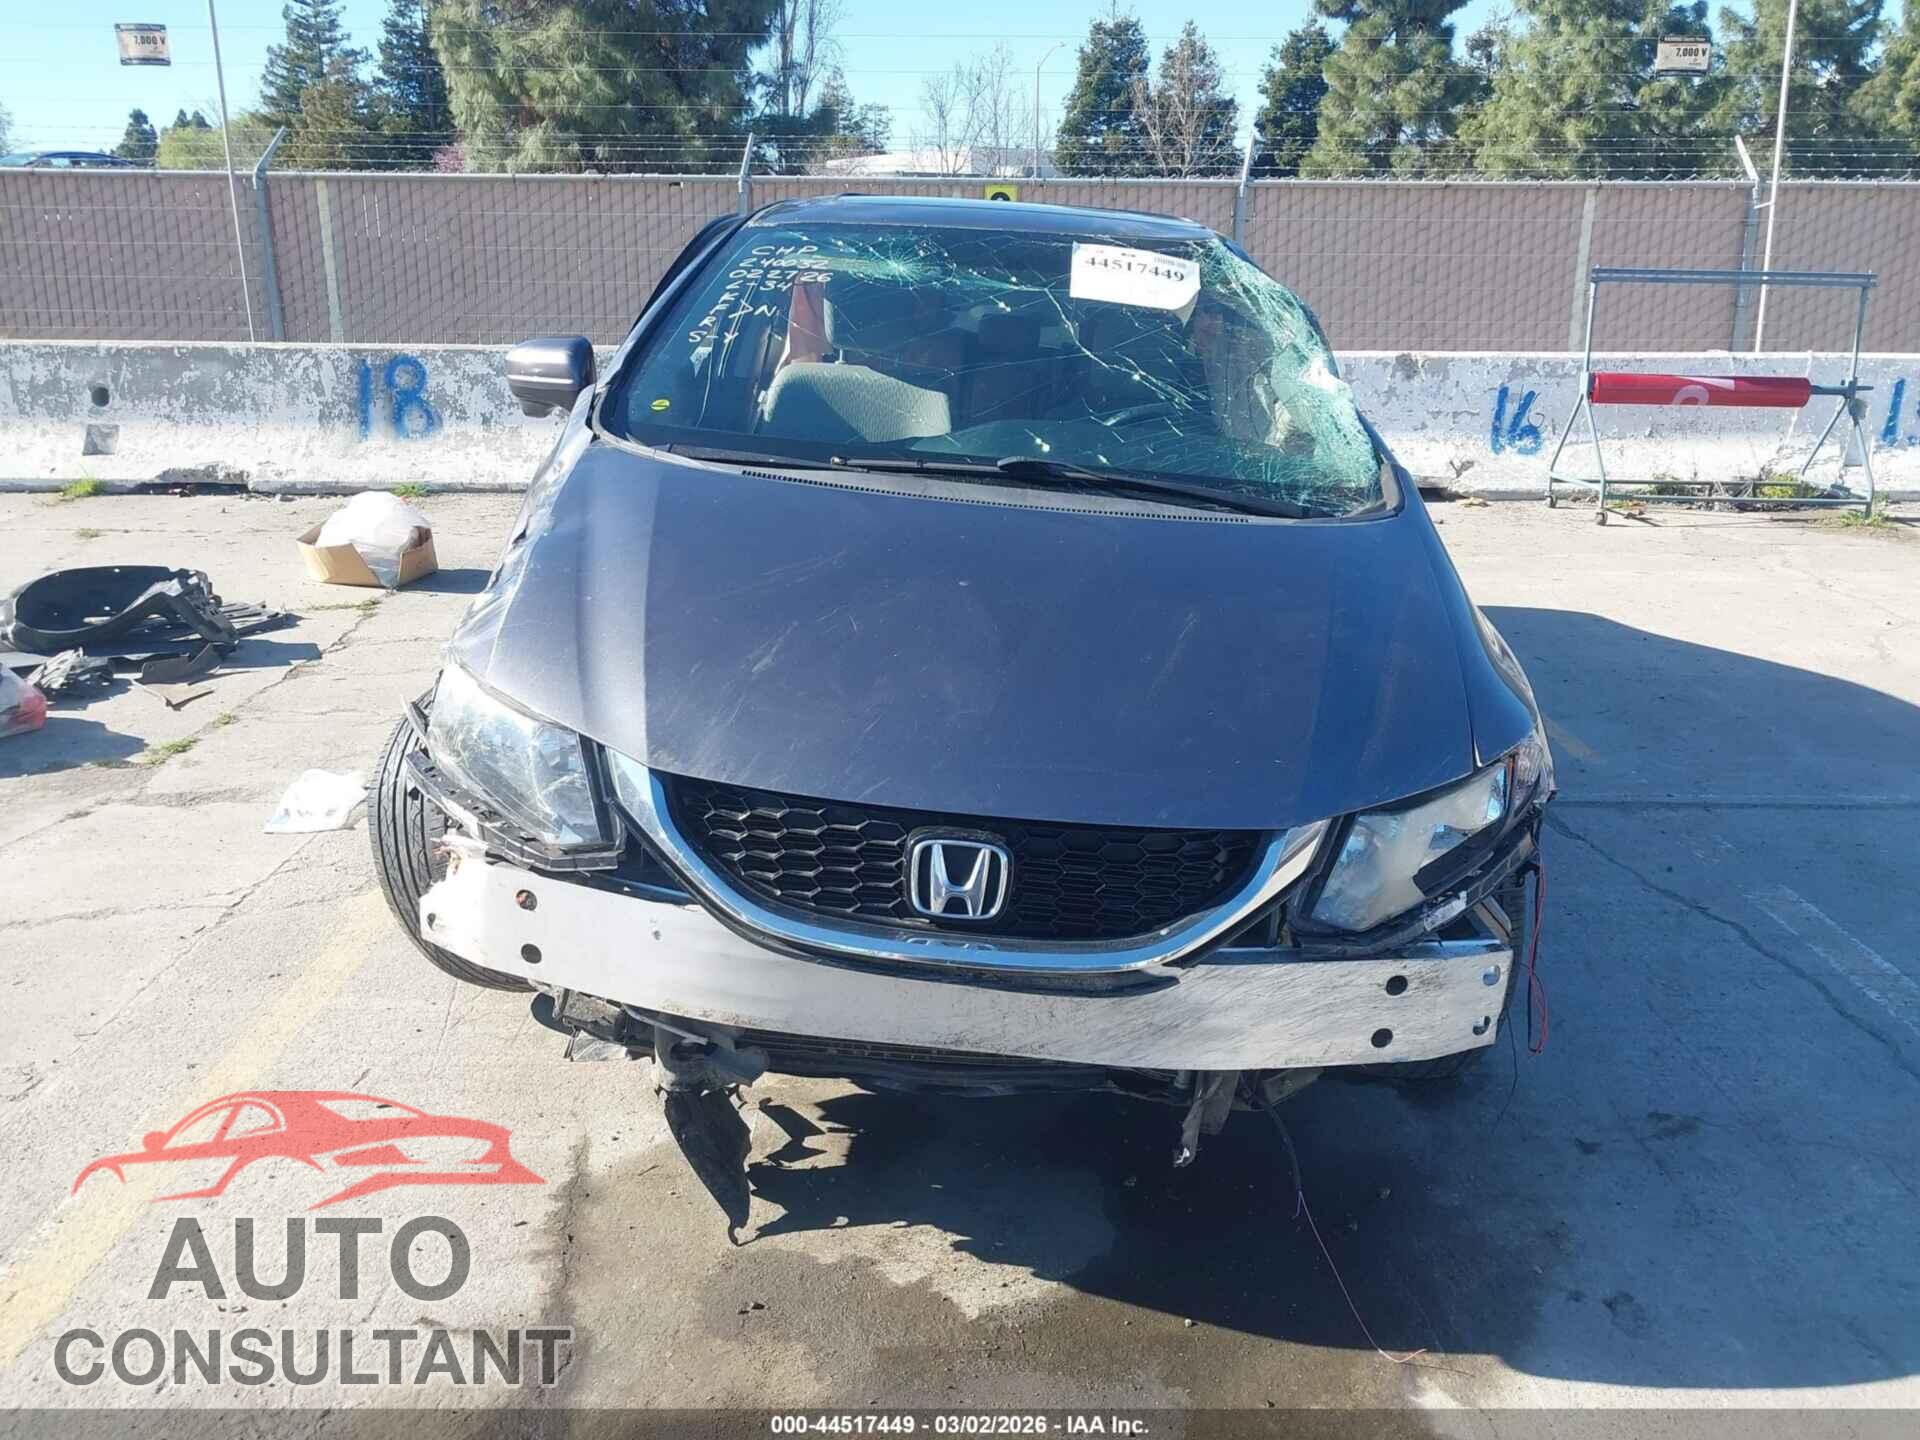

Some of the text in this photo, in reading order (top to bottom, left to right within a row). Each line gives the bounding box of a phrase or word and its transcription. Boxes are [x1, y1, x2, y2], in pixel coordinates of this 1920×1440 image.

[1676, 47, 1708, 58] 7,000 V
[752, 245, 818, 255] CHP
[1084, 256, 1185, 282] 44517449
[357, 353, 443, 441] 18
[1490, 386, 1542, 455] 16
